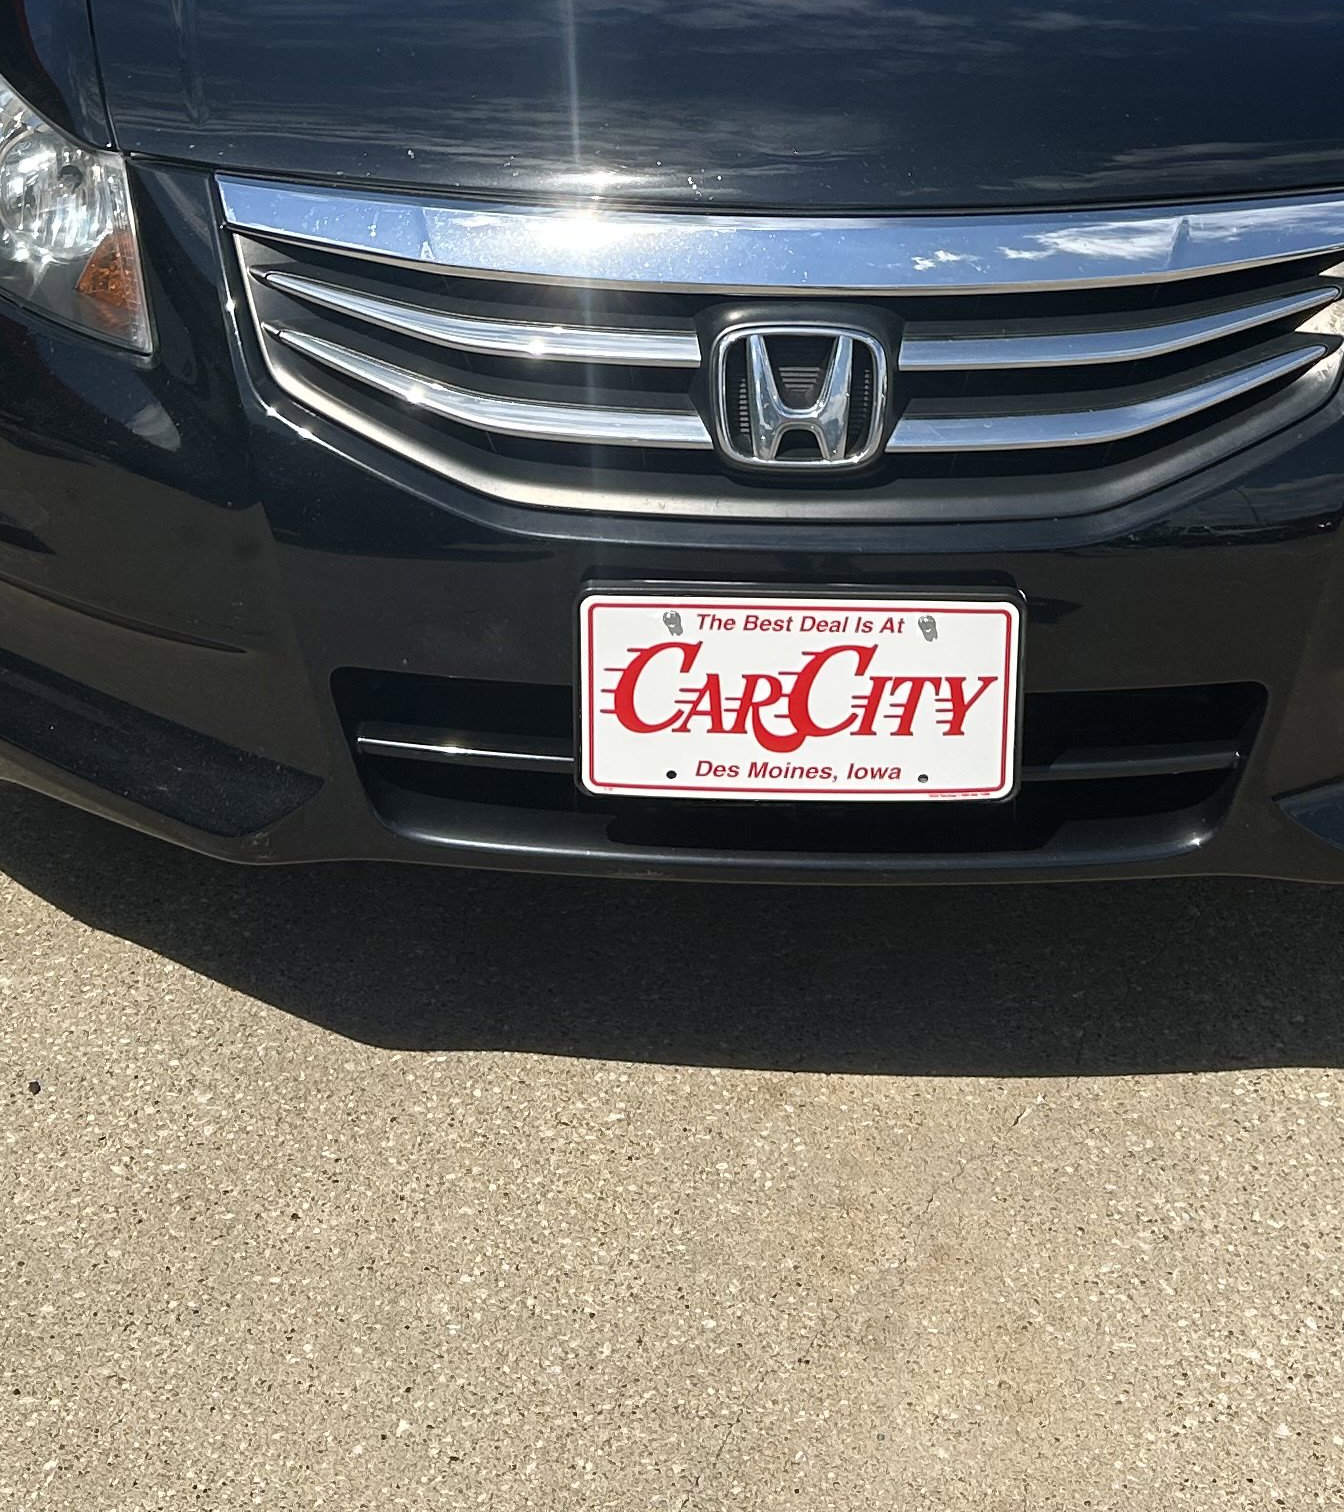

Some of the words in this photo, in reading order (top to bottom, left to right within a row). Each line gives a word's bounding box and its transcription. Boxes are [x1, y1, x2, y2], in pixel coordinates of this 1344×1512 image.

[697, 613, 736, 631] The
[743, 614, 794, 632] Best
[800, 615, 849, 633] Deal
[855, 616, 874, 633] Is
[879, 616, 905, 634] At
[695, 759, 740, 778] Des
[747, 761, 838, 782] Moines,
[846, 762, 902, 780] Iowa
